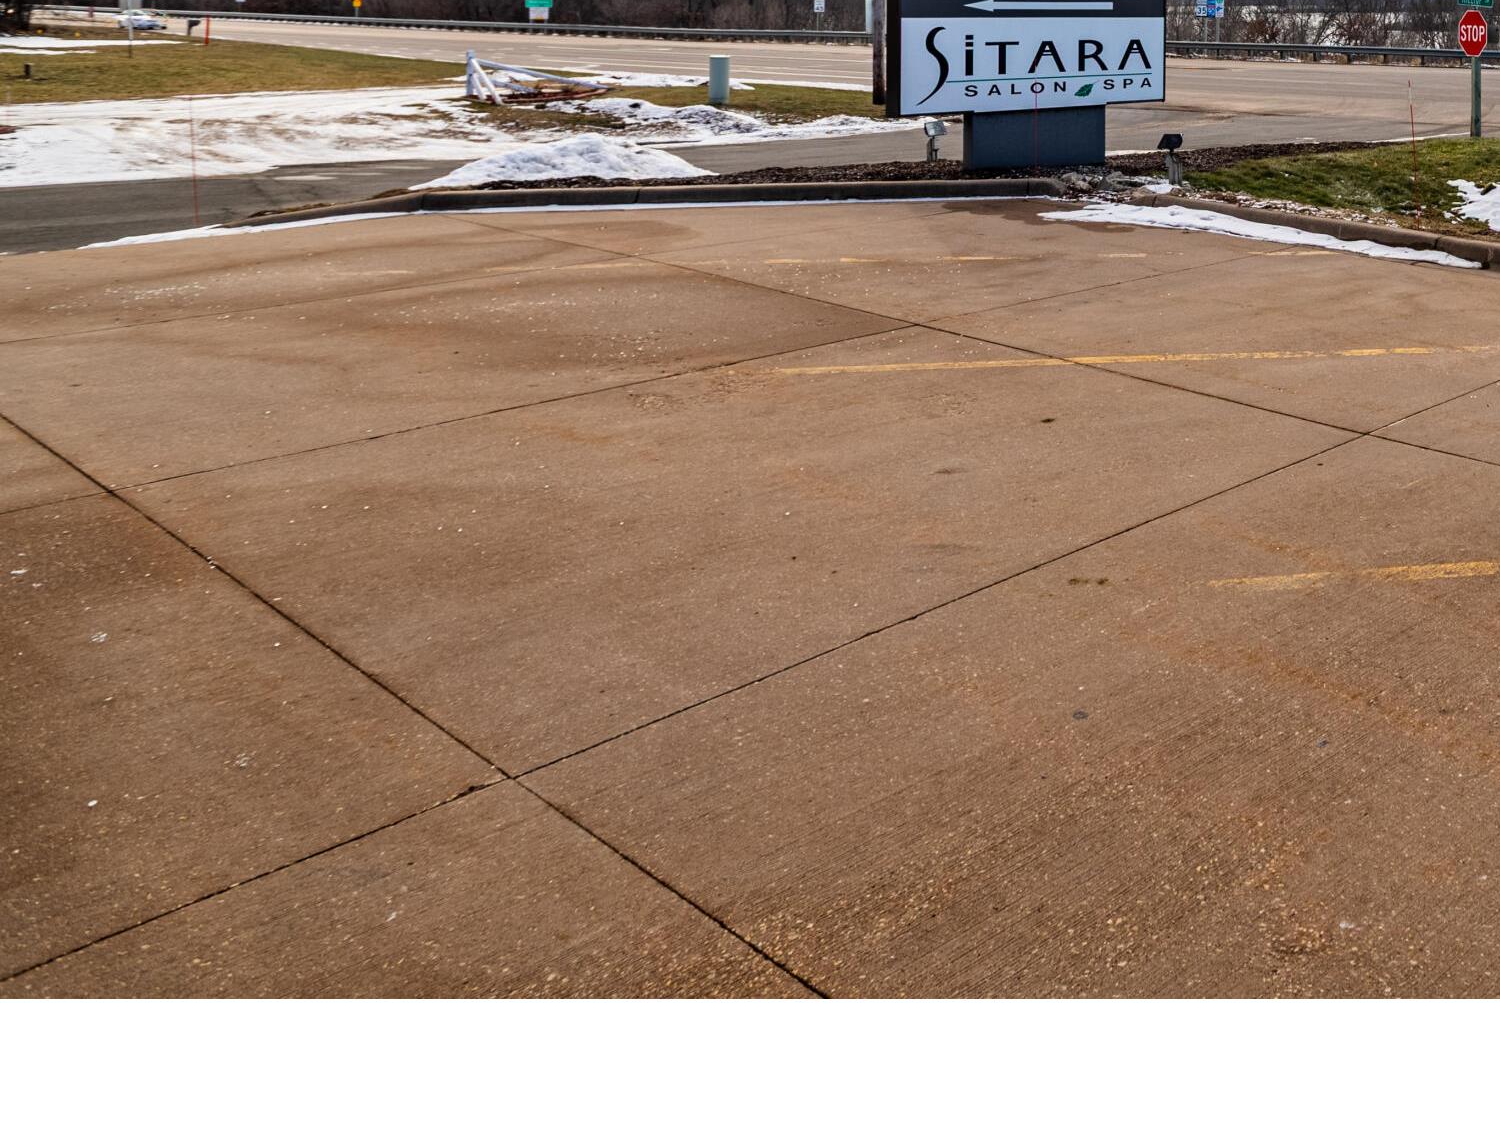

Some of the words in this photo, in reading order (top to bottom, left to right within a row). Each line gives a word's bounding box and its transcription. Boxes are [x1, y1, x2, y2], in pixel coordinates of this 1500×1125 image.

[1460, 25, 1485, 42] STOP
[964, 81, 1067, 97] SALON
[1103, 77, 1152, 90] SPA
